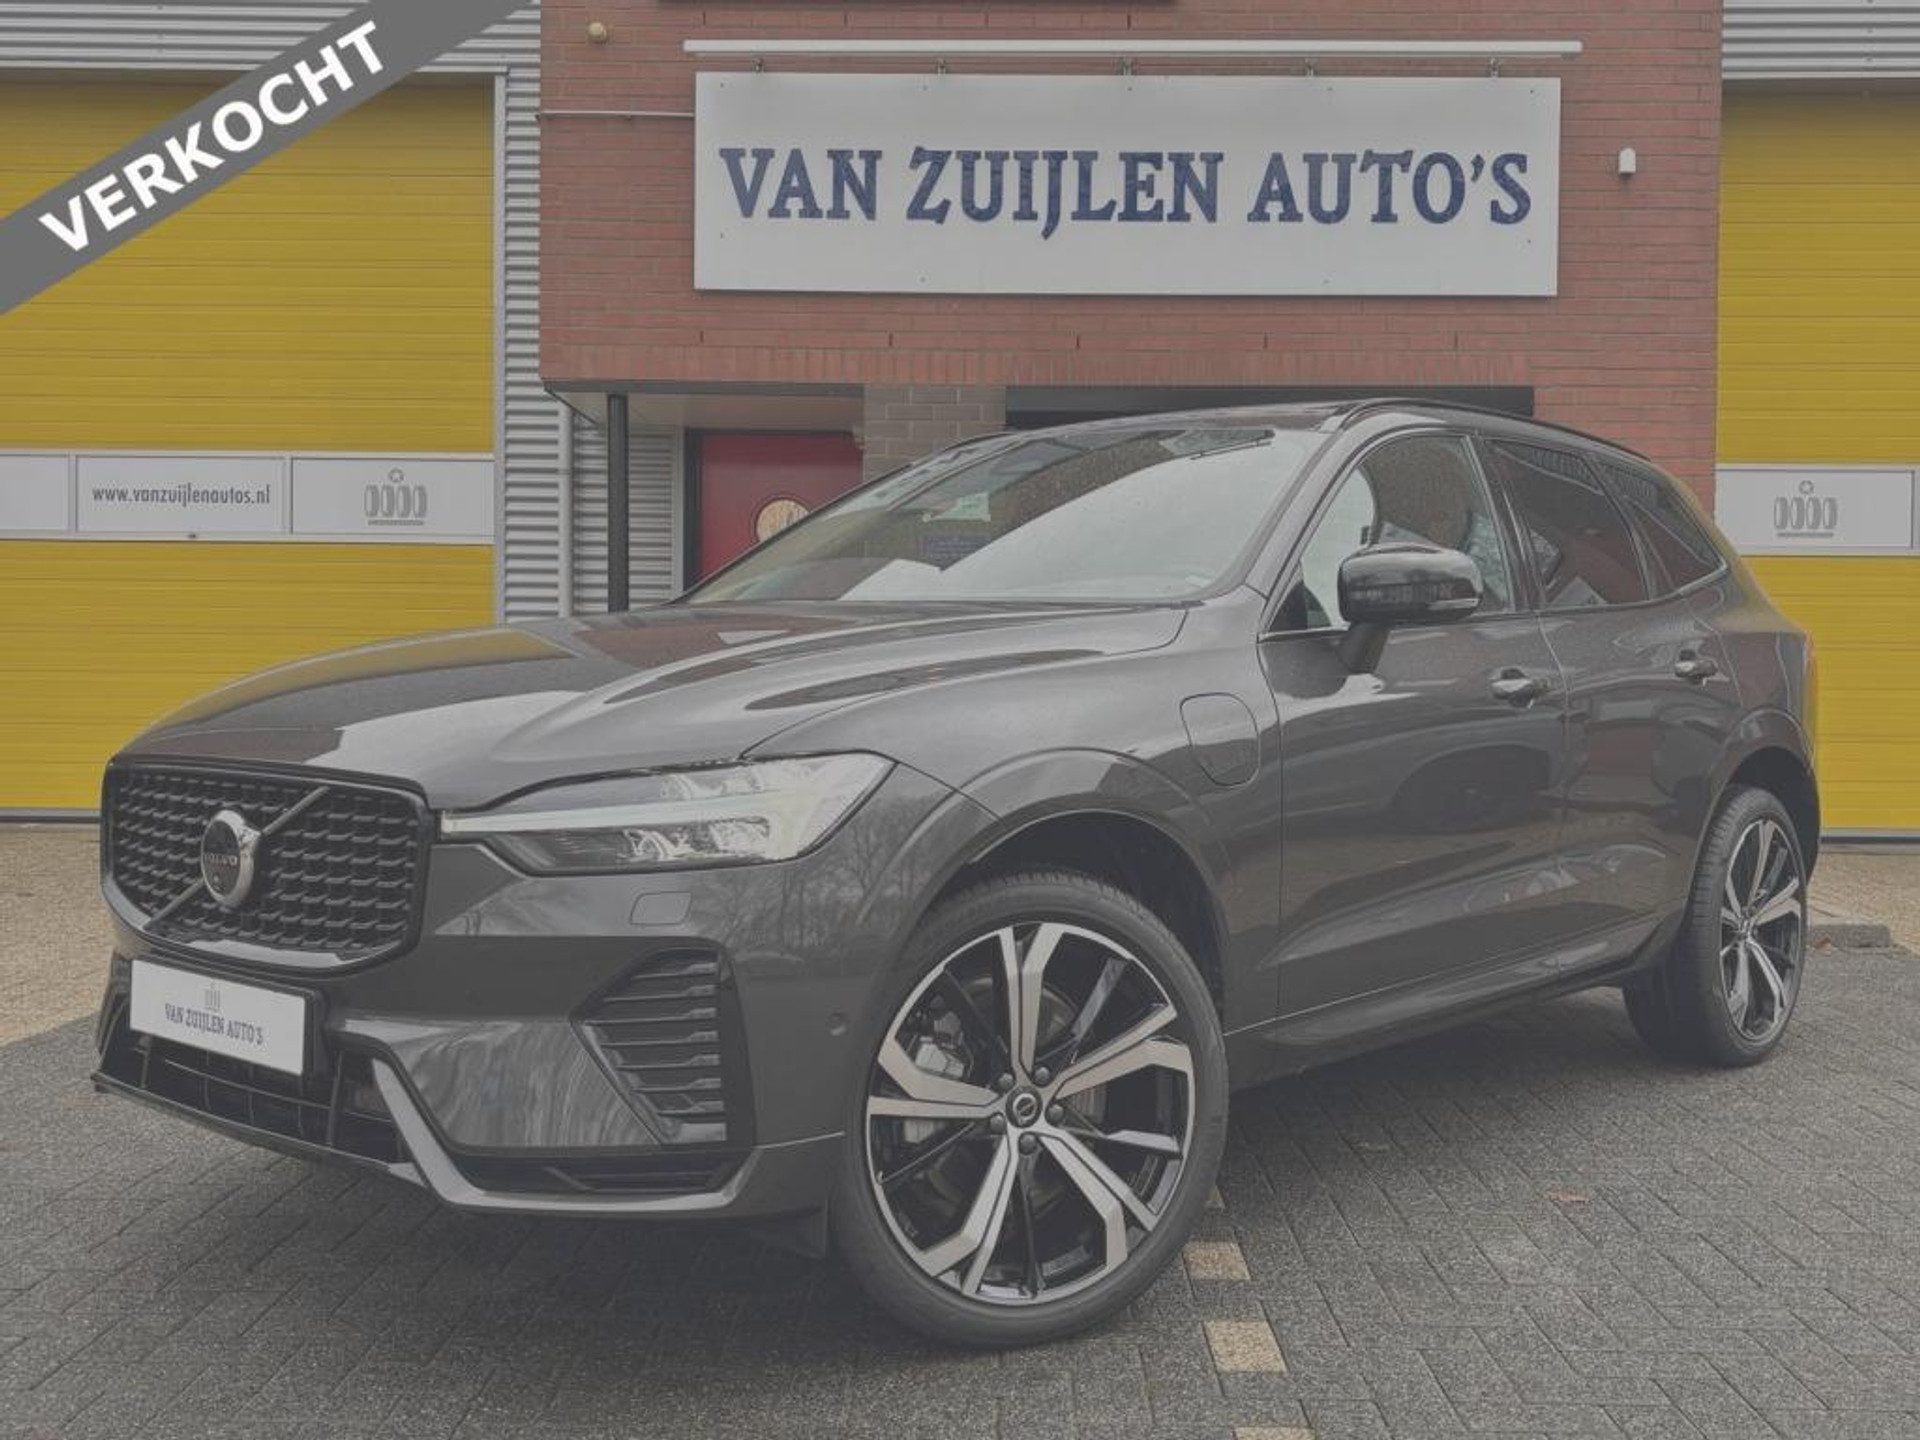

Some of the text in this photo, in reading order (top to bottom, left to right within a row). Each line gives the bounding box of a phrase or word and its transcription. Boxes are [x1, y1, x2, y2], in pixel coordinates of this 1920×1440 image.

[719, 145, 1532, 240] VAN ZUIJLEN AUTO'S
[92, 482, 270, 508] www.vanzuijlenautos.nl
[165, 1003, 184, 1023] VAN
[226, 1020, 264, 1045] AUTOS
